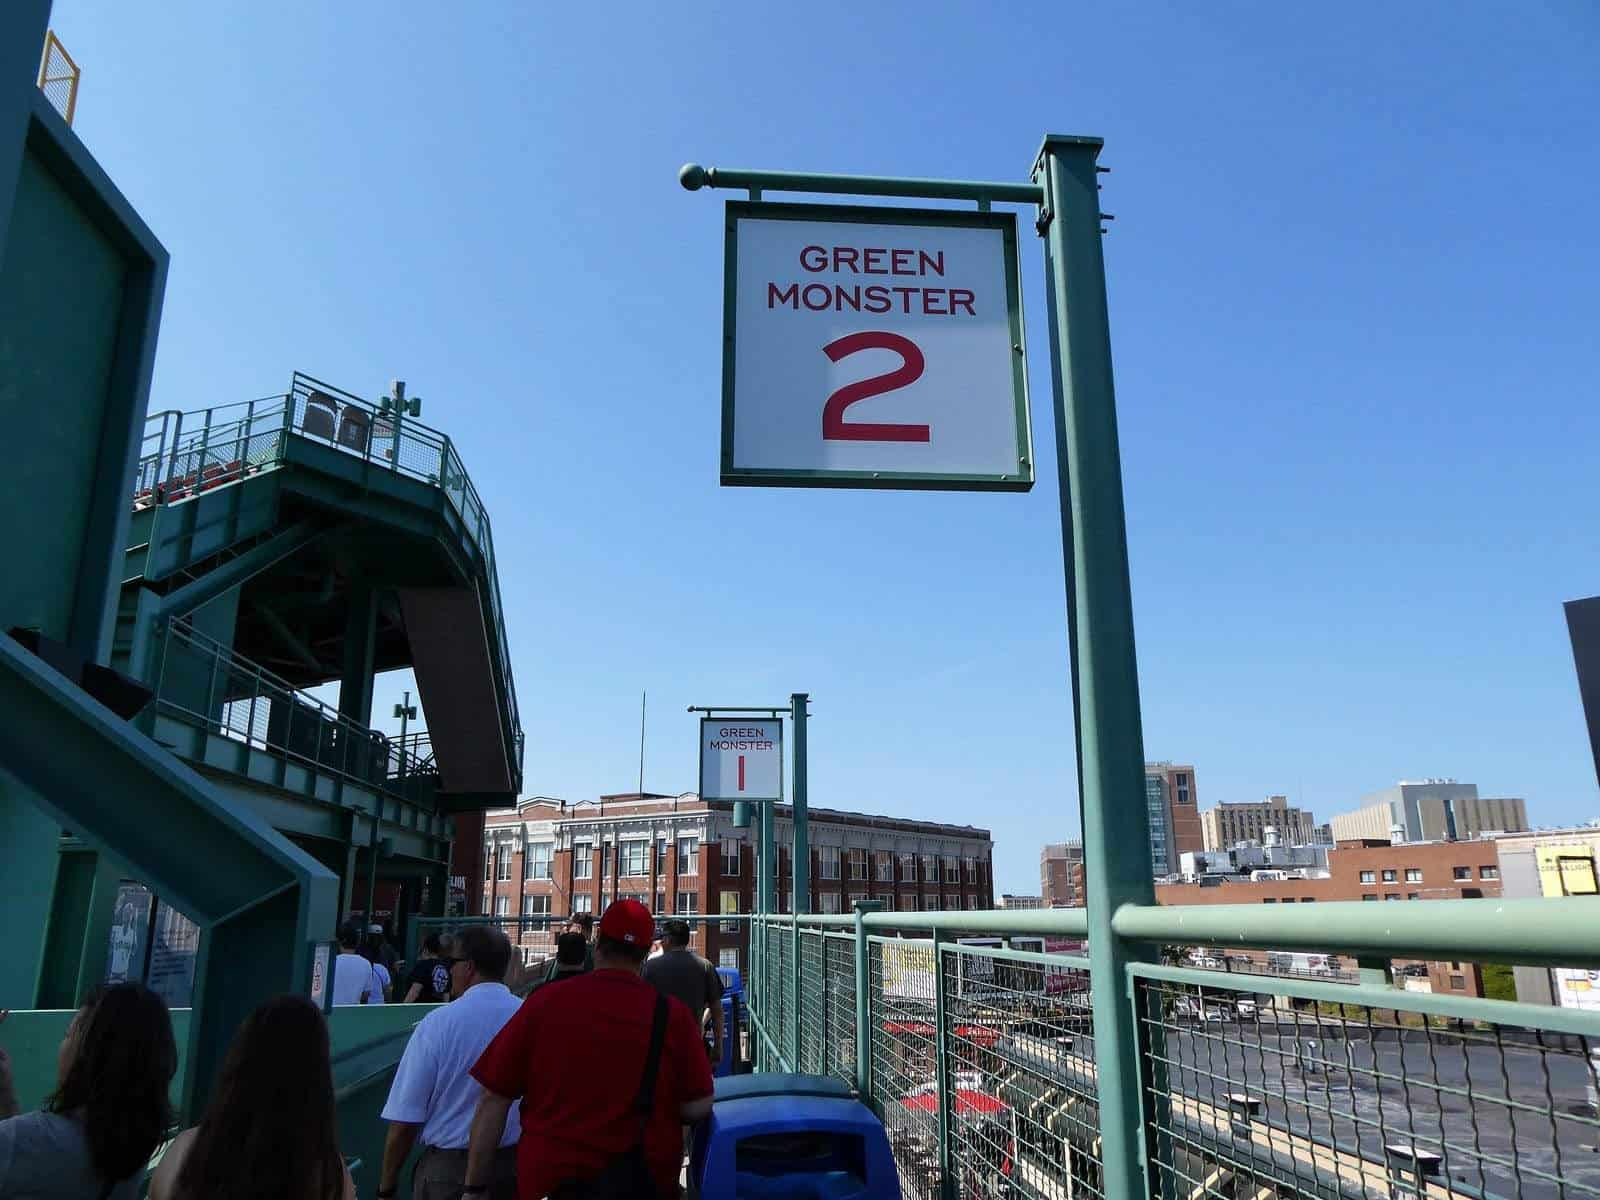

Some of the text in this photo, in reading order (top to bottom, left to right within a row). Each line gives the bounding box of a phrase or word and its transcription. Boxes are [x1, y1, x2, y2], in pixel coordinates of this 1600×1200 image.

[800, 246, 944, 276] GREEN
[768, 282, 976, 316] MONSTER
[822, 331, 930, 442] 2
[710, 741, 773, 750] MONSTER
[720, 728, 764, 738] GREEN
